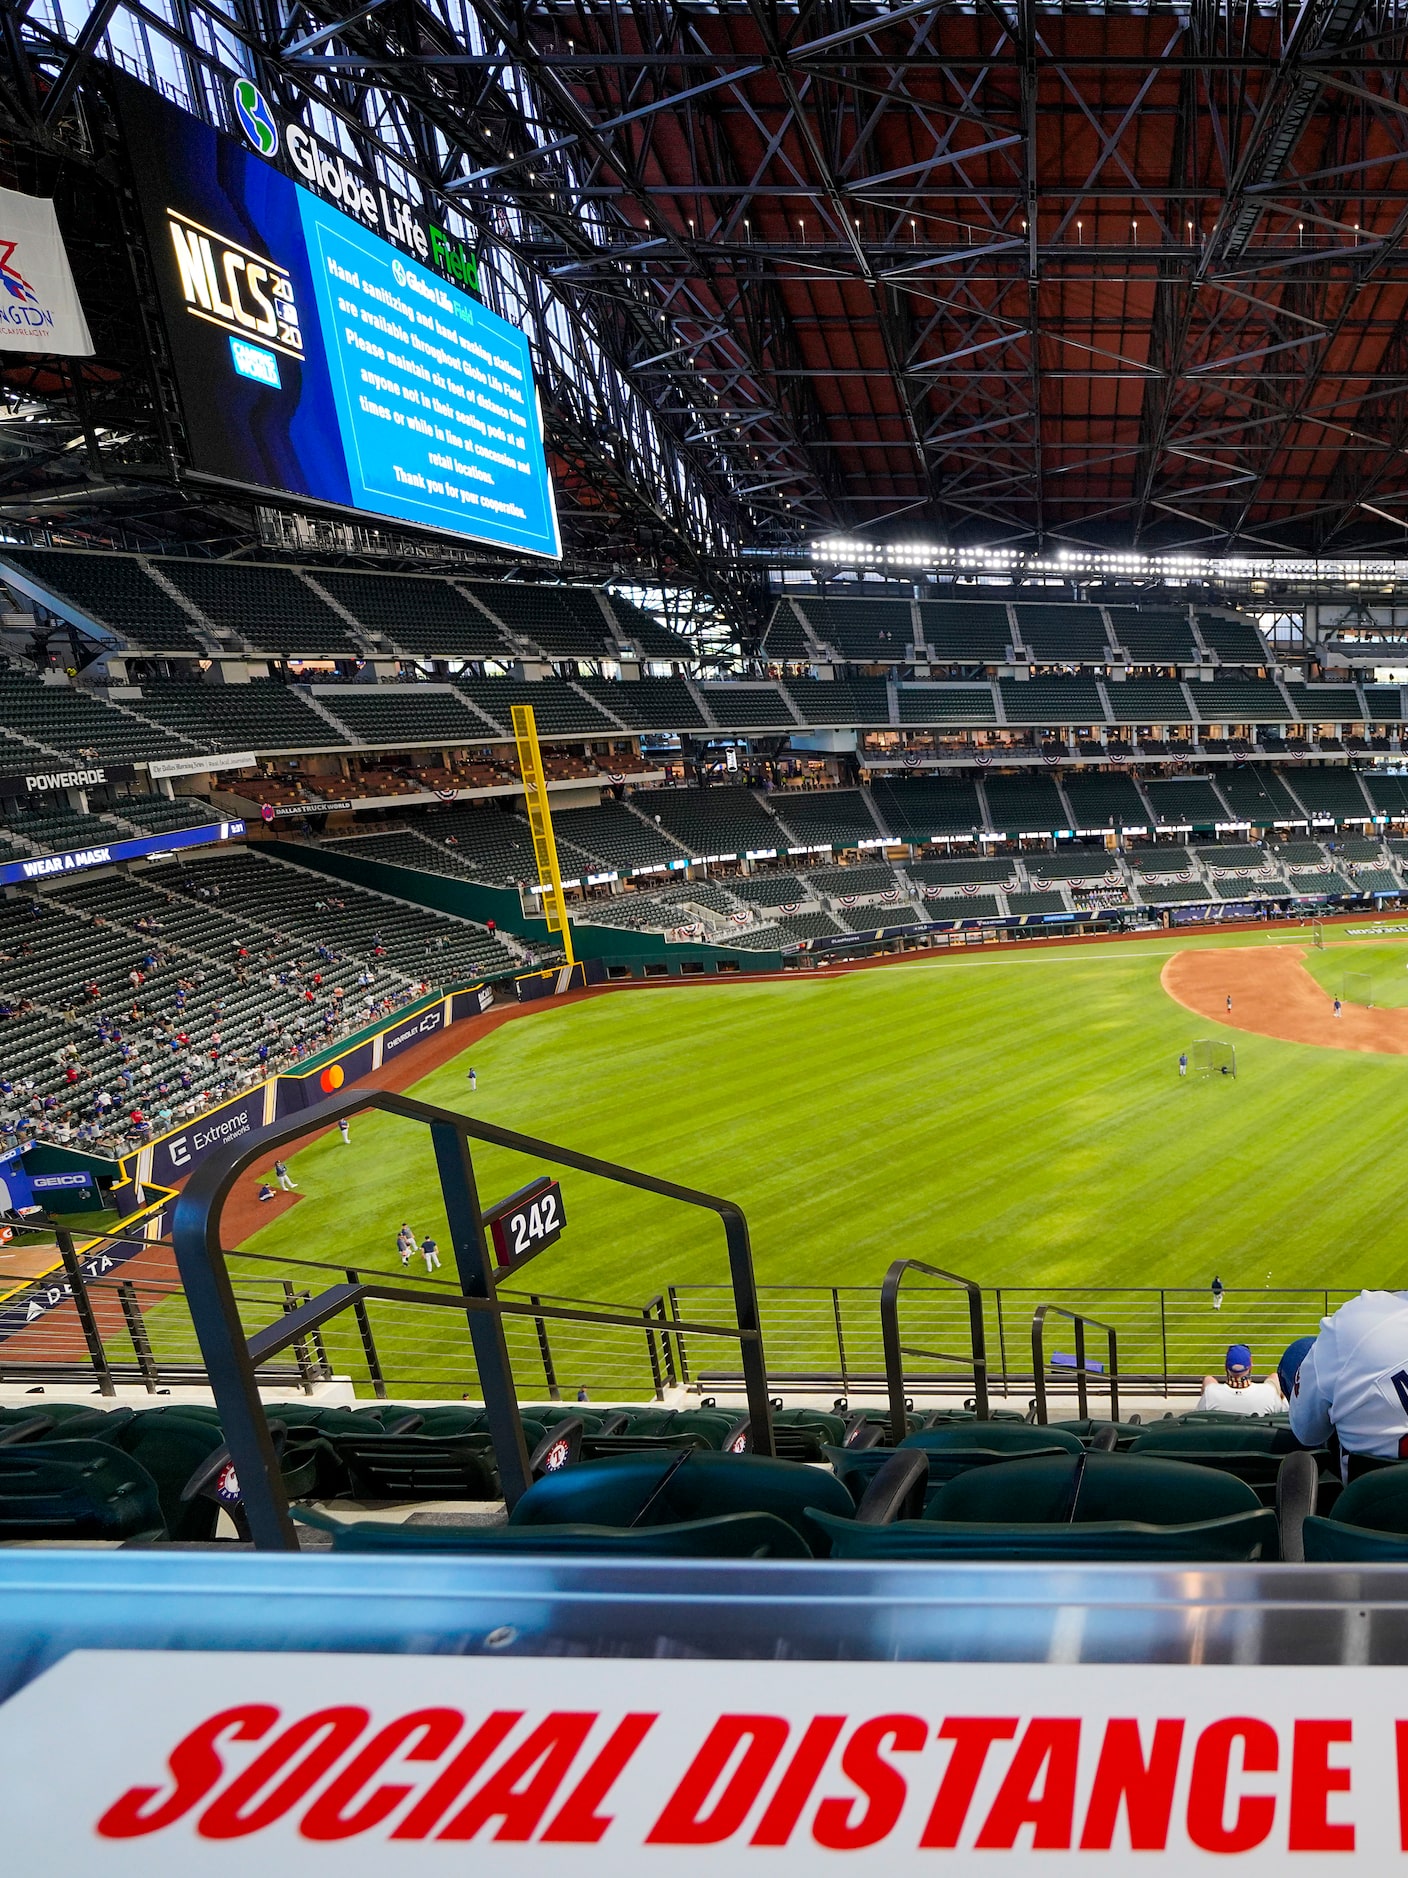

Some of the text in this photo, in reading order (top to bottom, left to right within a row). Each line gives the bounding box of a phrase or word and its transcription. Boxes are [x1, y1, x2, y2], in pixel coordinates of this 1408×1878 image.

[286, 123, 480, 292] Globe Life Field
[169, 220, 277, 338] NLCS
[269, 273, 294, 303] 20
[406, 271, 474, 326] Globe Life Field
[279, 325, 303, 350] 20
[327, 256, 523, 381] Hand sanitizing and hand washing stations
[338, 296, 359, 318] are
[360, 308, 410, 345] available
[410, 332, 463, 372] throughout
[462, 360, 487, 385] Globe
[488, 373, 503, 393] Life
[345, 327, 527, 428] Please maintain six feet of distance from
[360, 367, 526, 450] anyone not in their seating pods at all
[359, 395, 531, 475] times or while in line at concession and
[393, 465, 527, 520] Thank you for your cooperation.
[428, 451, 495, 485] retail locations.
[26, 768, 107, 792] POWERADE
[153, 765, 162, 773] The
[276, 802, 350, 815] DALLAS TRUCK WORLD
[23, 848, 111, 877] WEAR A MASK
[387, 1026, 418, 1050] CHEVROLET
[193, 1112, 248, 1151] Extreme
[223, 1124, 251, 1144] networks
[34, 1174, 87, 1188] GEICO
[510, 1194, 560, 1255] 242
[47, 1255, 113, 1305] DETA
[95, 1704, 659, 1844] SOCIAL
[644, 1714, 1356, 1851] DISTANCE
